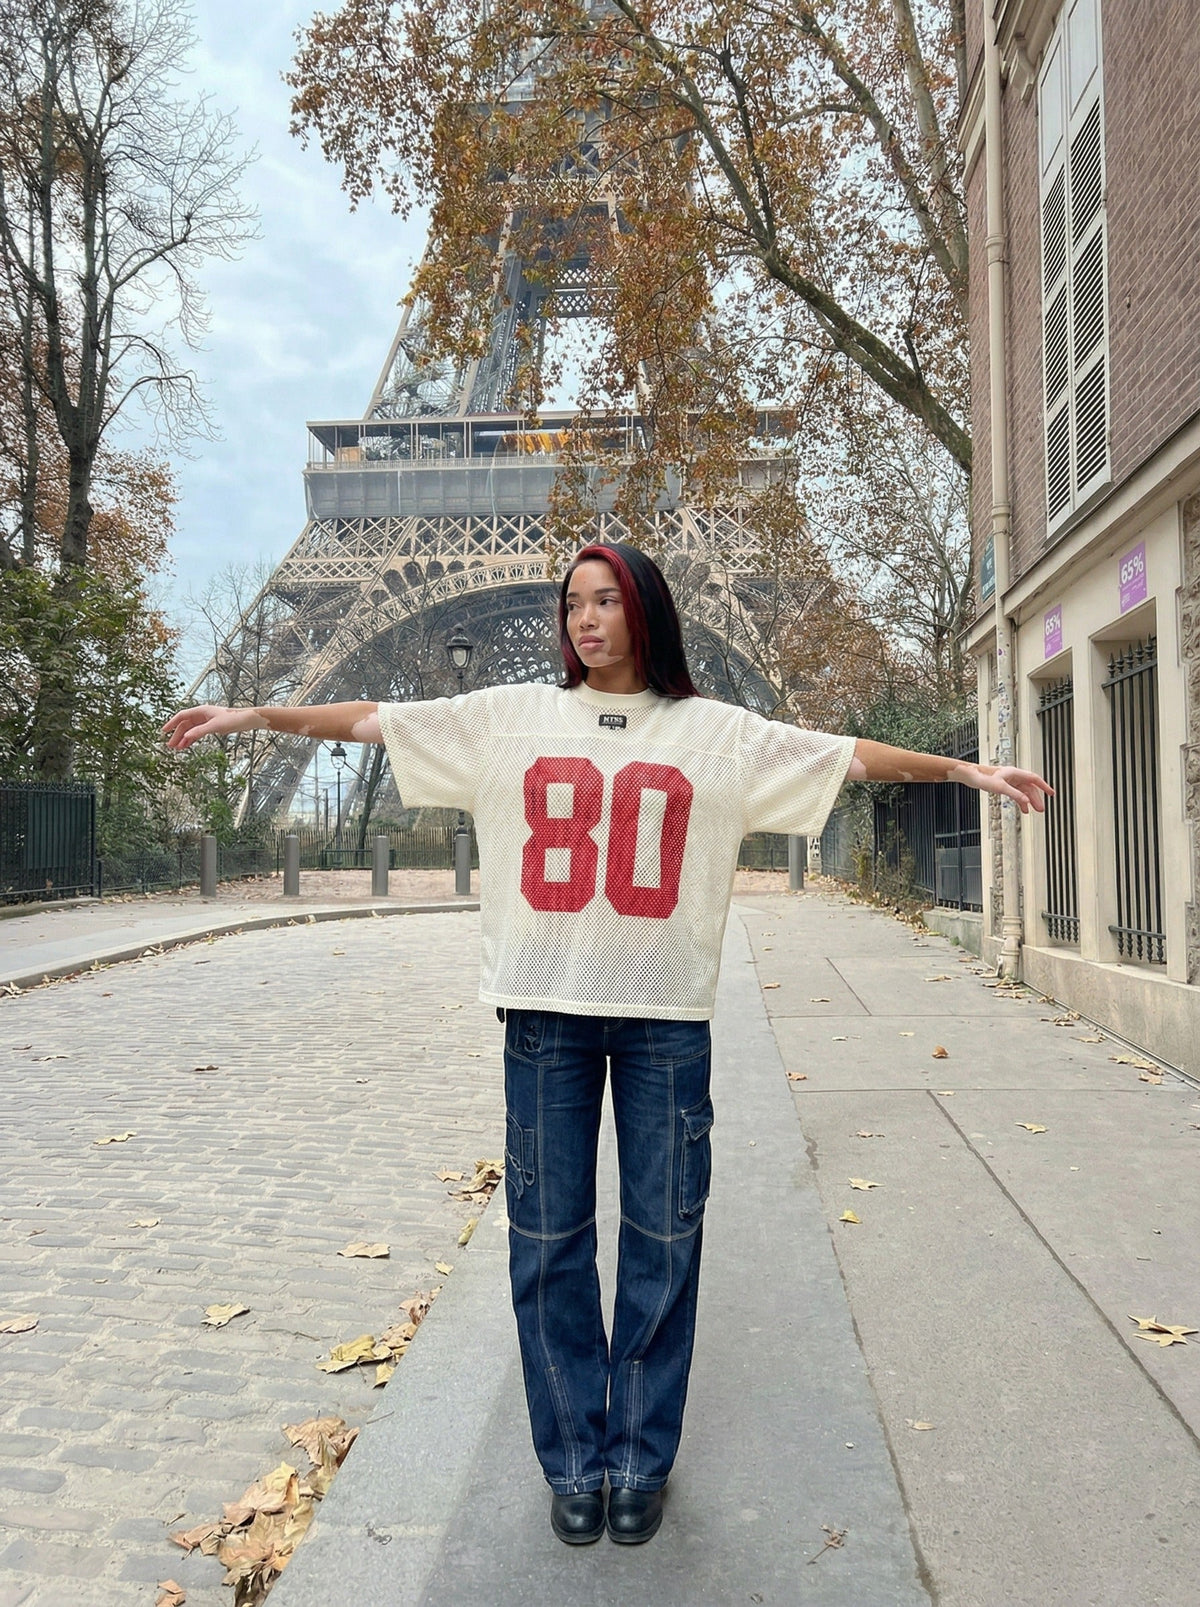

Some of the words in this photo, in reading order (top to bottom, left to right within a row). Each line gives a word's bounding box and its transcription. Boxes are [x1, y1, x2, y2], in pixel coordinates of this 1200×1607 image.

[1121, 552, 1144, 584] 65%
[1045, 613, 1061, 636] 65%
[520, 756, 694, 919] 80
